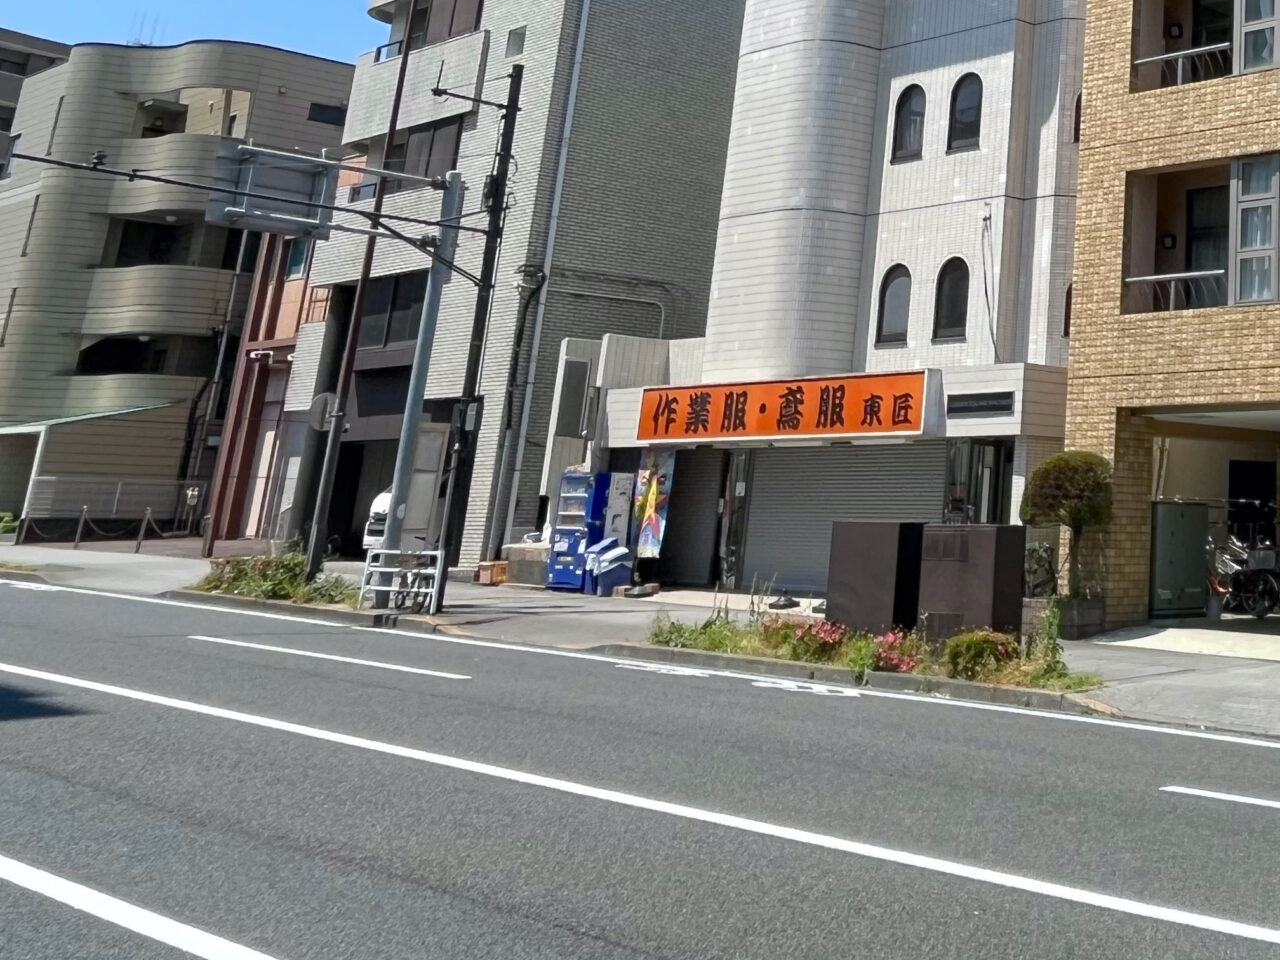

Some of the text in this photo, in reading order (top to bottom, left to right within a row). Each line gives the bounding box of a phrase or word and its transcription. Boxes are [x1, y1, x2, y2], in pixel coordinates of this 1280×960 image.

[652, 384, 846, 436] 作業服・鳶服
